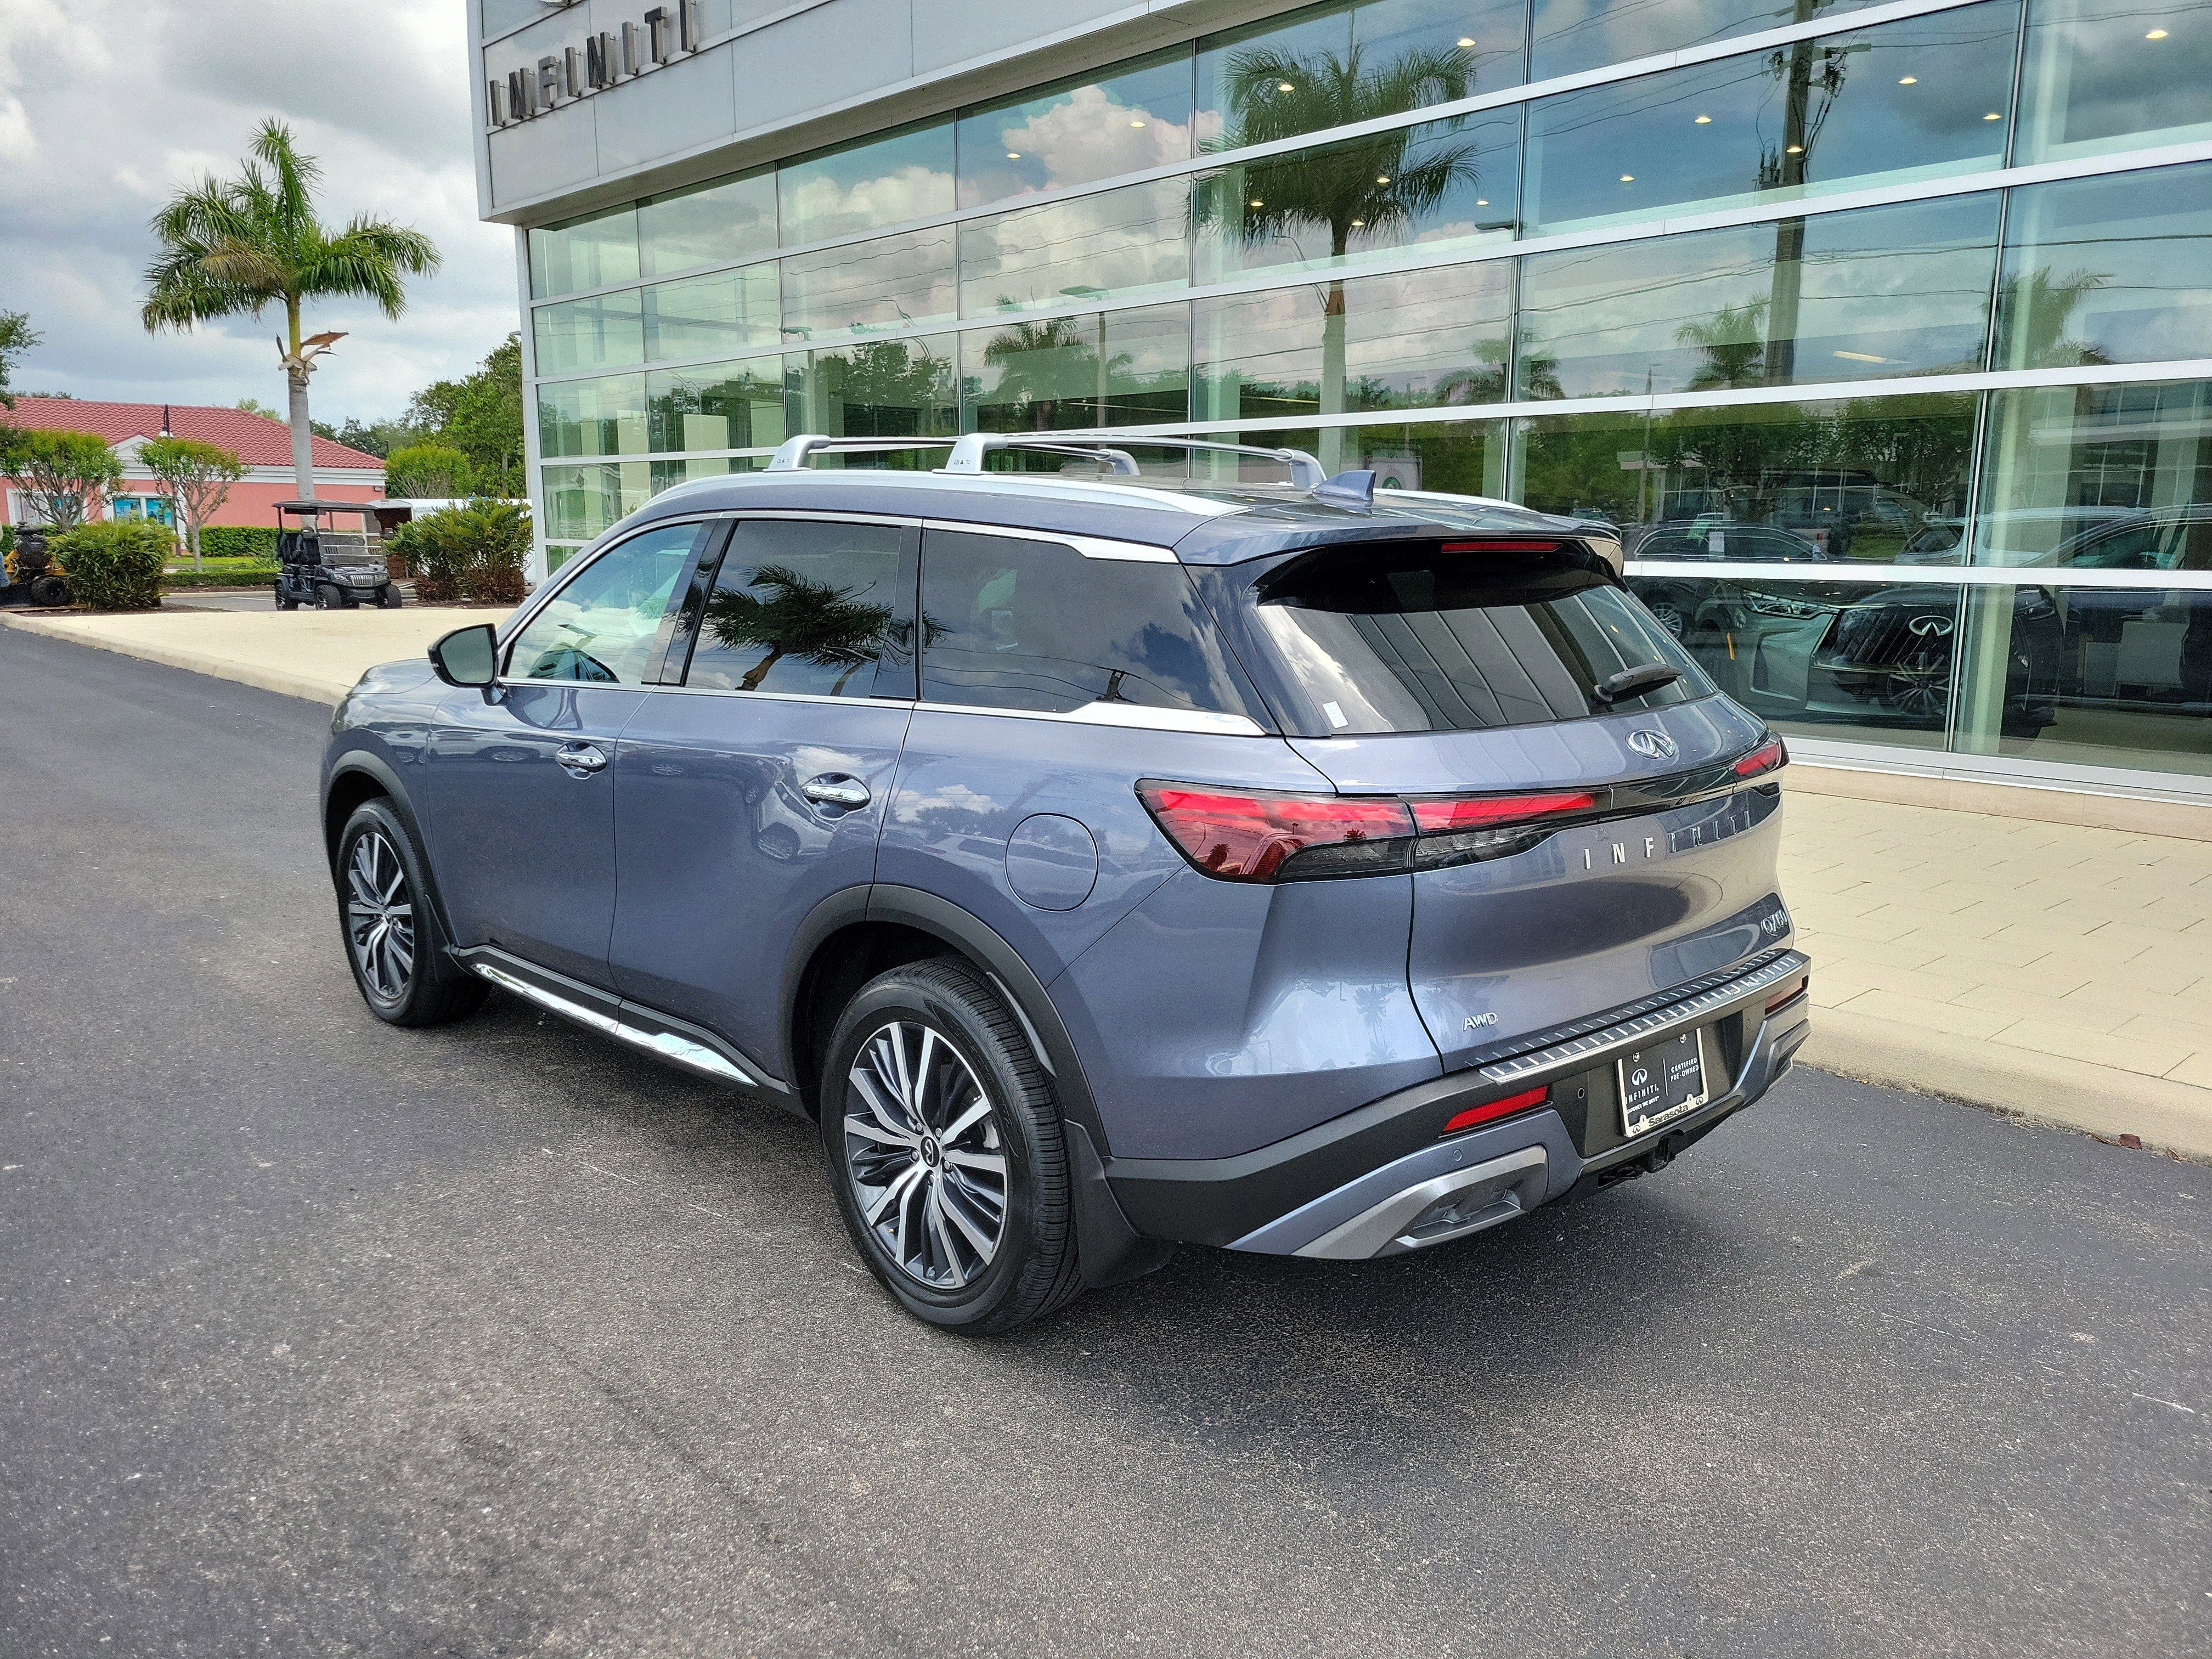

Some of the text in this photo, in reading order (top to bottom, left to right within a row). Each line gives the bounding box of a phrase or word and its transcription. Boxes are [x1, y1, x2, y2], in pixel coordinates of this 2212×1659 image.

[489, 0, 697, 127] INFINITI
[1584, 811, 1751, 870] INFINITI
[1462, 1012, 1498, 1031] AWD
[1670, 1064, 1699, 1082] PRE-OWNED
[1671, 1057, 1697, 1073] CERTIFIED
[1648, 1104, 1689, 1127] Sarasota
